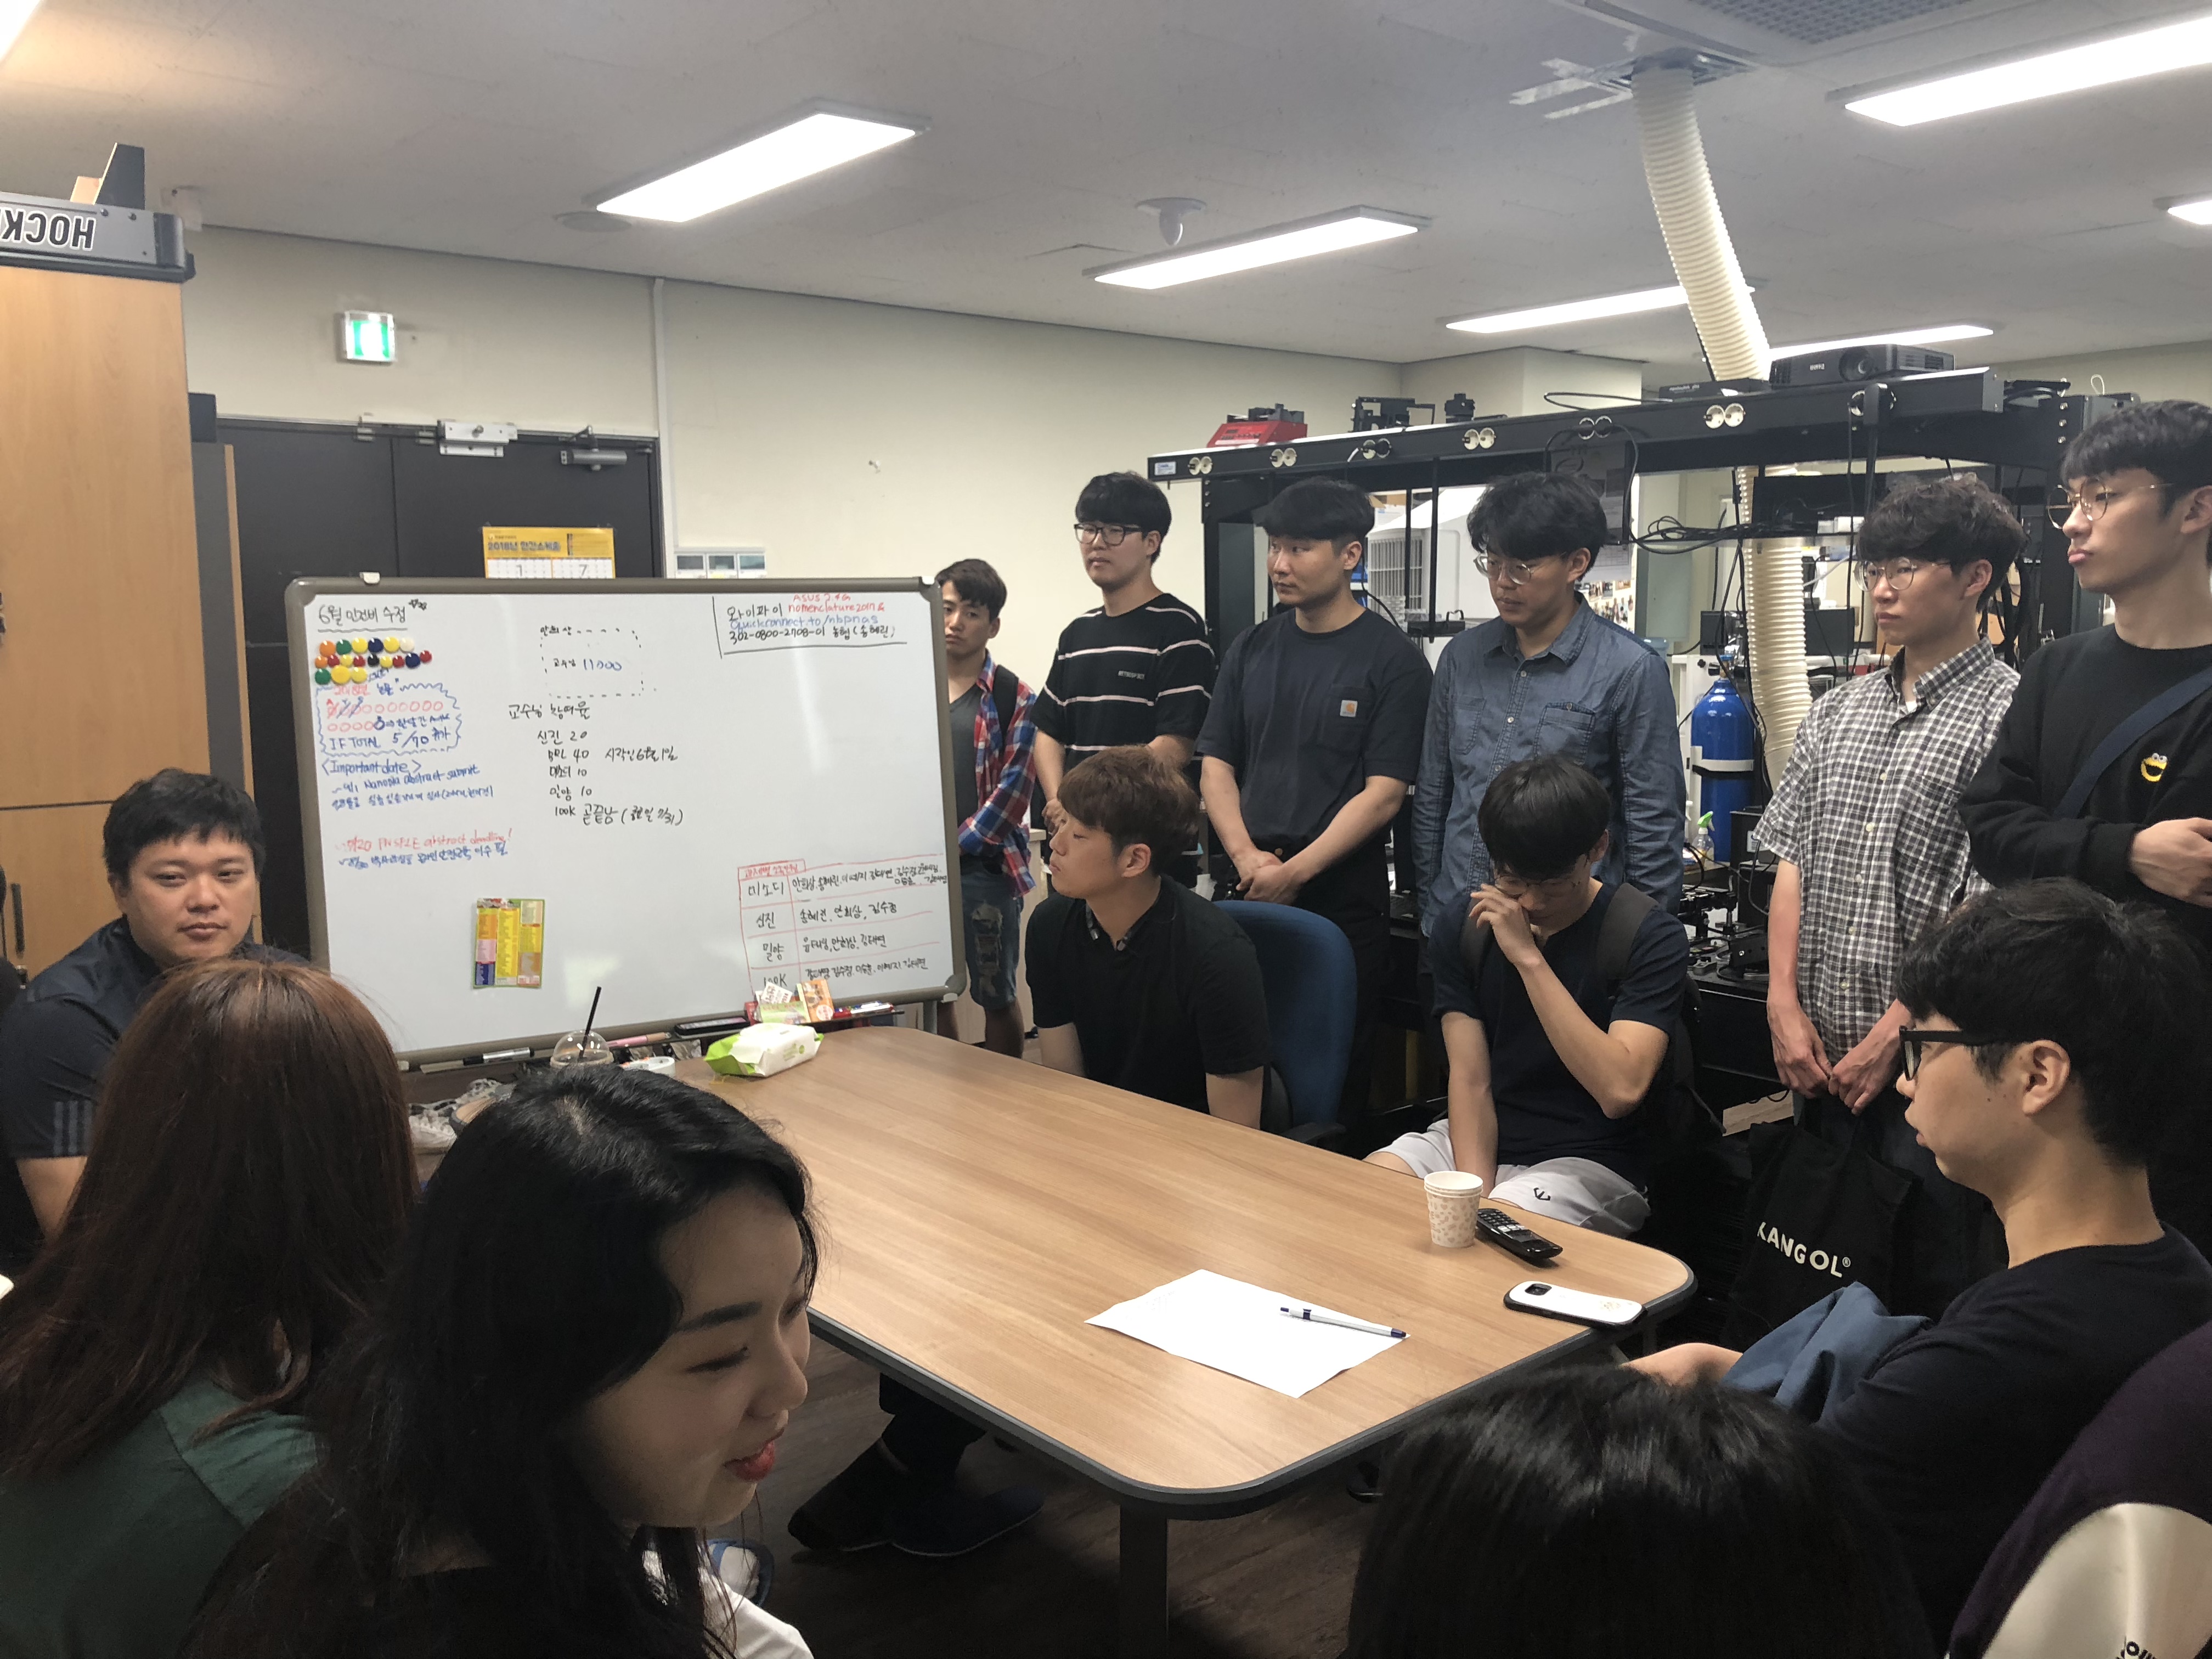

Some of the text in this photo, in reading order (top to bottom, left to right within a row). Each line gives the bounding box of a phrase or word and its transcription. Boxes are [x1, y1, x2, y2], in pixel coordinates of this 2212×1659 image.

[0, 207, 96, 251] HOCK
[793, 594, 820, 602] ASUS
[319, 604, 405, 627] 6월 인건비 수정
[727, 602, 783, 621] 와이파이
[583, 658, 623, 672] 11000
[509, 703, 543, 719] 교수님
[348, 736, 381, 748] TOTAL
[537, 730, 588, 746] 신진 20
[573, 748, 589, 764] 40
[578, 768, 588, 777] 10
[581, 786, 592, 797] 10
[748, 881, 784, 896] 미소디
[756, 911, 776, 929] 신진
[763, 942, 785, 962] 밀양
